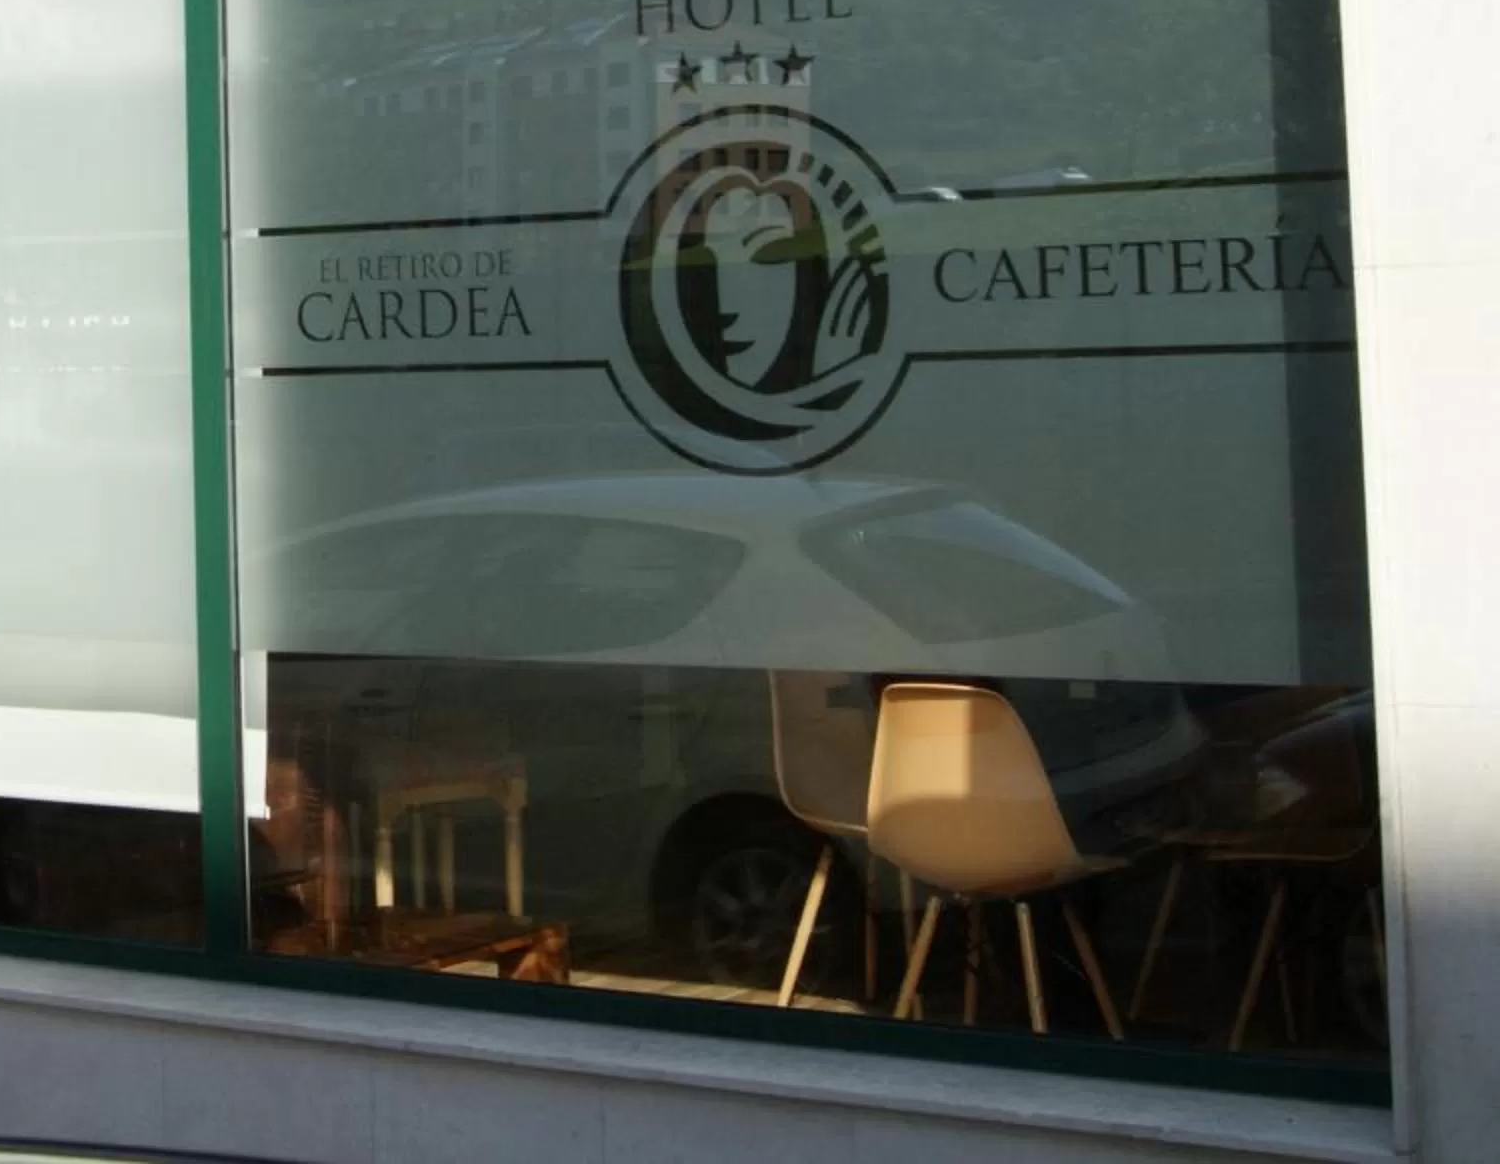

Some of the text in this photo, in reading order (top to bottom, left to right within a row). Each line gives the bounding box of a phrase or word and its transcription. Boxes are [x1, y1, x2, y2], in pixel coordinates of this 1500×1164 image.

[319, 249, 513, 283] EL RETIRO DE
[933, 214, 1348, 303] CAFETERÍA
[297, 286, 532, 342] CARDEA
